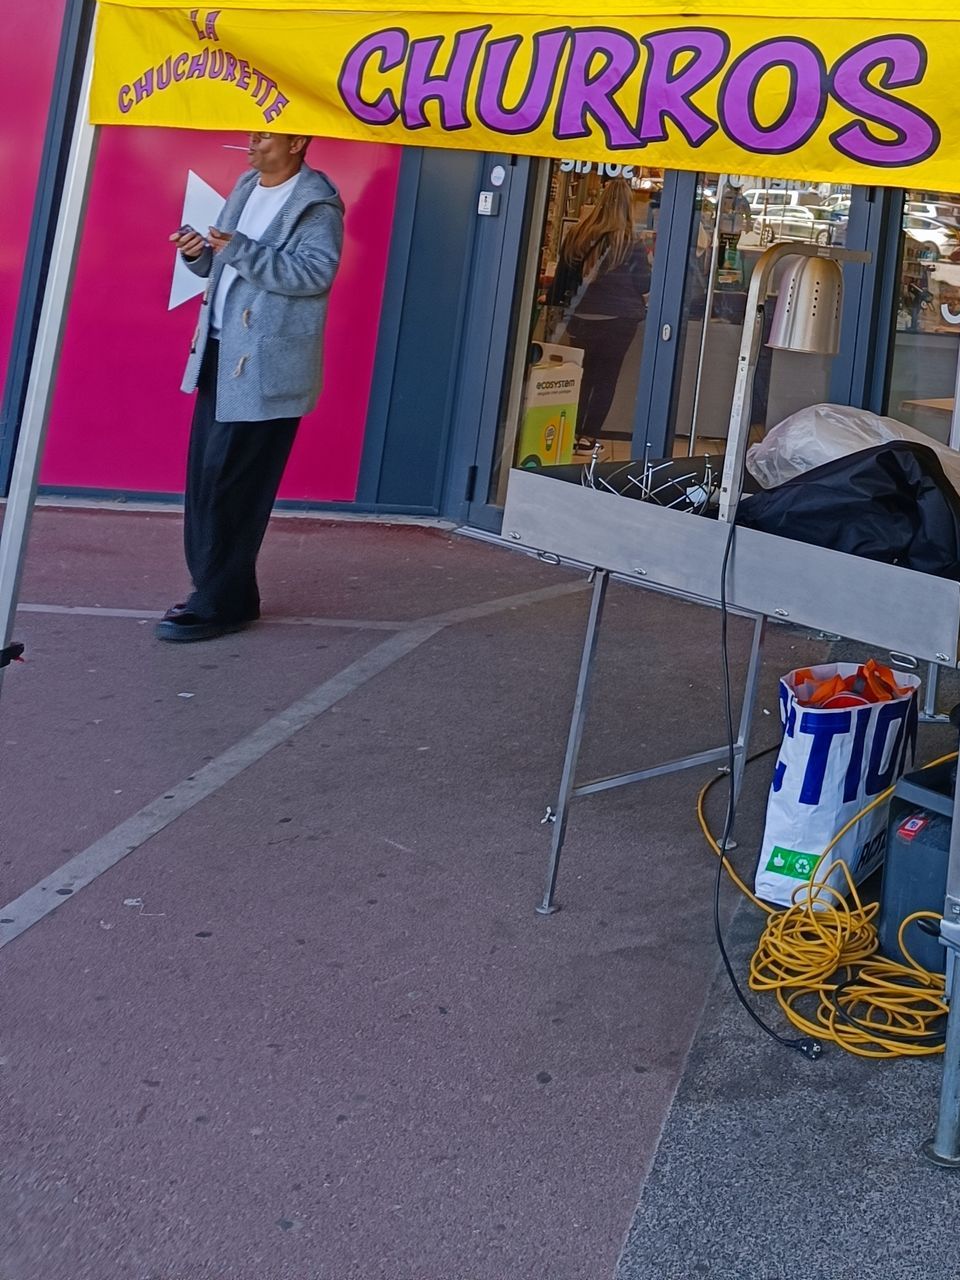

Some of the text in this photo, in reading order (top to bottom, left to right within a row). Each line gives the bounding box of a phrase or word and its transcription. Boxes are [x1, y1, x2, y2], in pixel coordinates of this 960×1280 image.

[190, 9, 222, 42] LA
[117, 46, 290, 124] CHUCHURETTE
[337, 23, 942, 168] CHURROS
